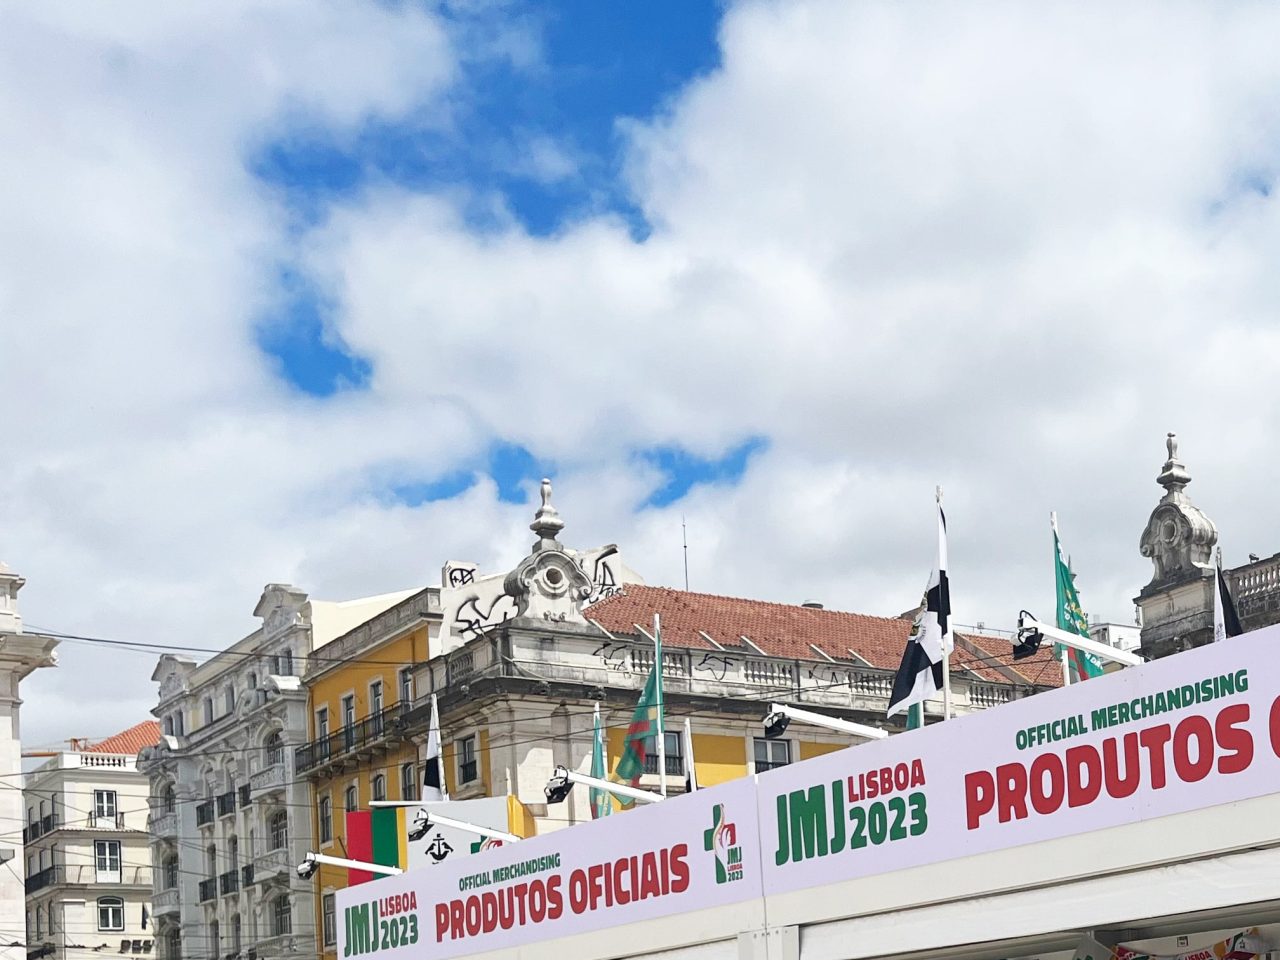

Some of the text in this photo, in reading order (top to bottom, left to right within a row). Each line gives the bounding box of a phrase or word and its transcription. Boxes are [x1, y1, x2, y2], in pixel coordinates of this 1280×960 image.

[1016, 669, 1249, 750] OFFICIAL MERCHANDISING
[848, 758, 926, 803] LISBOA
[963, 703, 1253, 830] PRODUTOS
[775, 779, 928, 866] JMJ 2023
[459, 852, 561, 892] OFFICIAL MERCHANDISING
[727, 846, 742, 865] JMJ
[728, 870, 743, 882] 2023
[379, 891, 417, 917] LISBOA
[435, 843, 690, 943] PRODUTOS OFICIAIS
[344, 900, 419, 958] JMJ 2023
